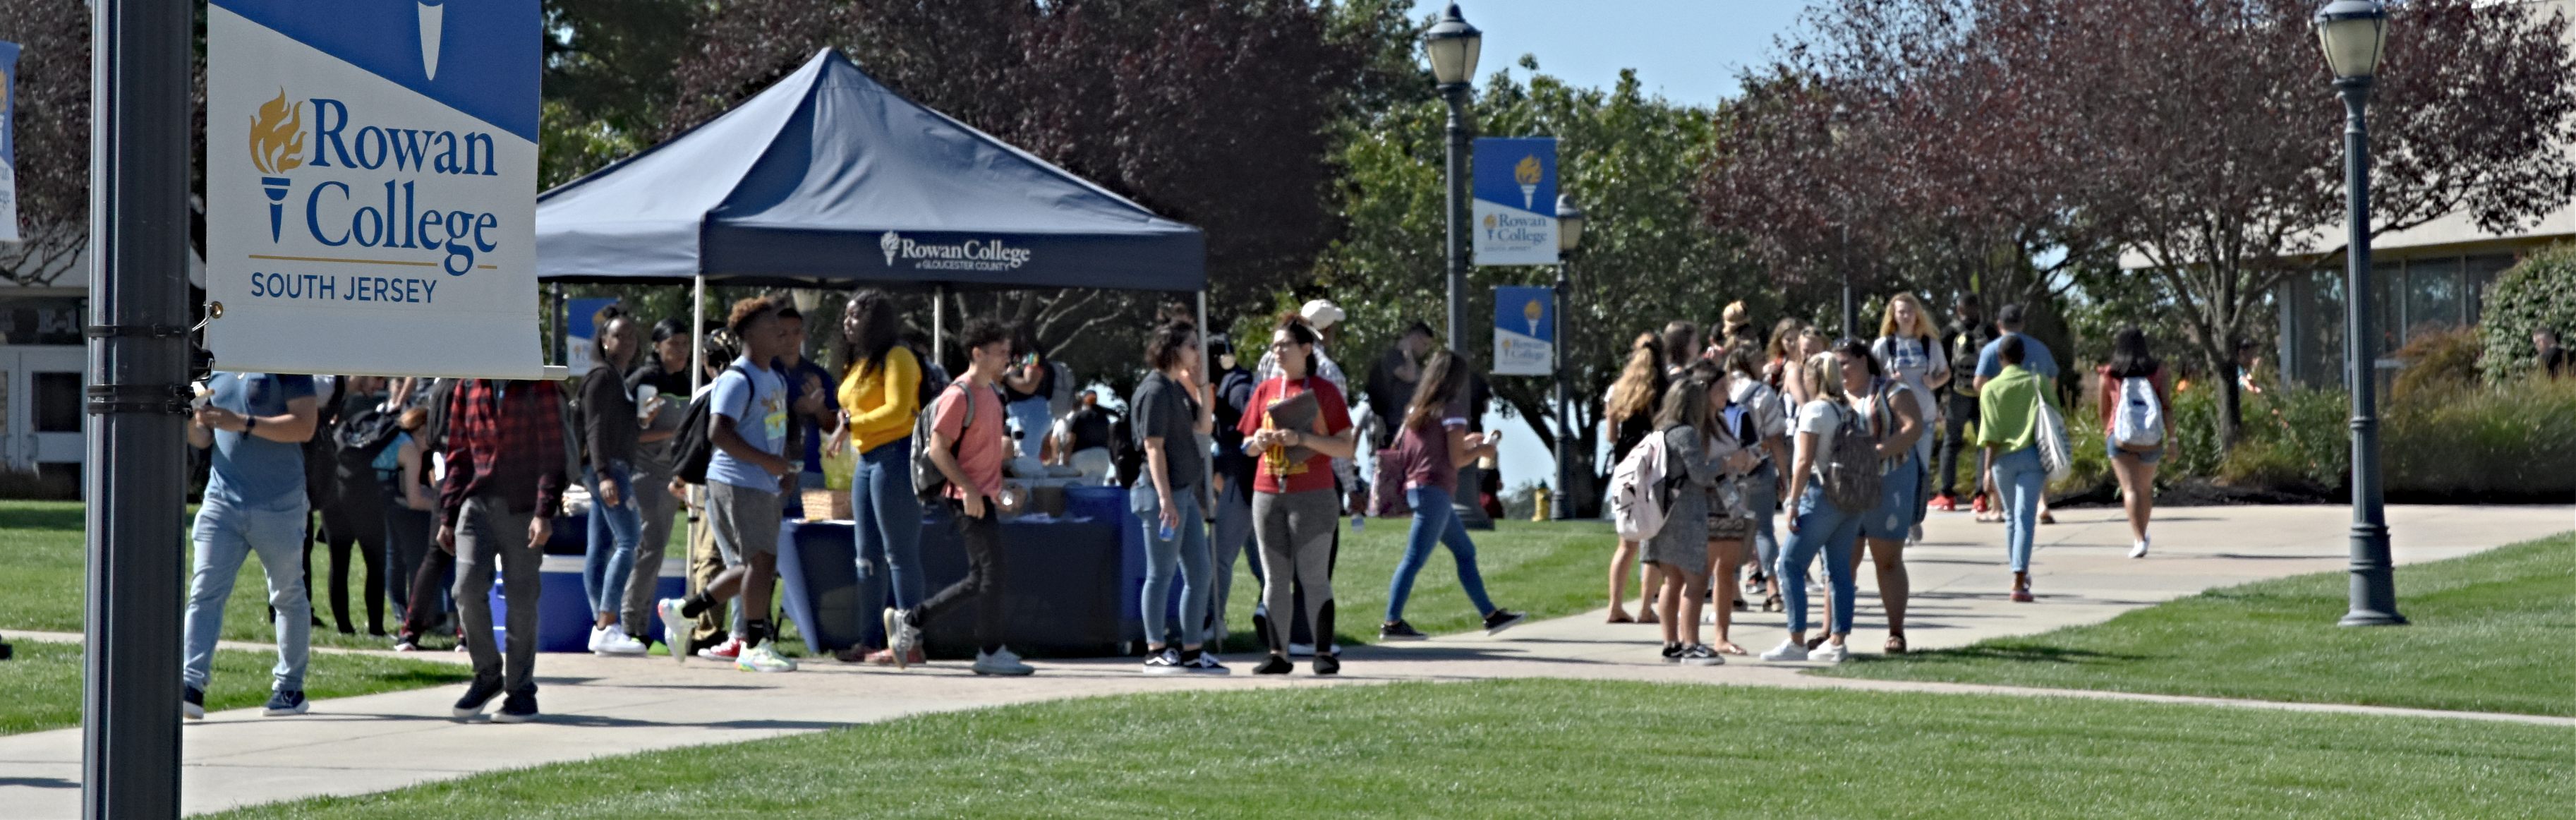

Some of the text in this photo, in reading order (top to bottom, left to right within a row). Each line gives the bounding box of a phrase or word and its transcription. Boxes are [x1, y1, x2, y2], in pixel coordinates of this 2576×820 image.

[309, 98, 498, 176] Rowan
[306, 179, 497, 277] College
[1499, 214, 1547, 227] Rowan
[1498, 228, 1547, 245] College
[902, 239, 1030, 268] Rowan College
[922, 259, 974, 270] GLOUCESTER
[975, 261, 1010, 271] COUNTY
[251, 272, 437, 303] SOUTH JERSEY
